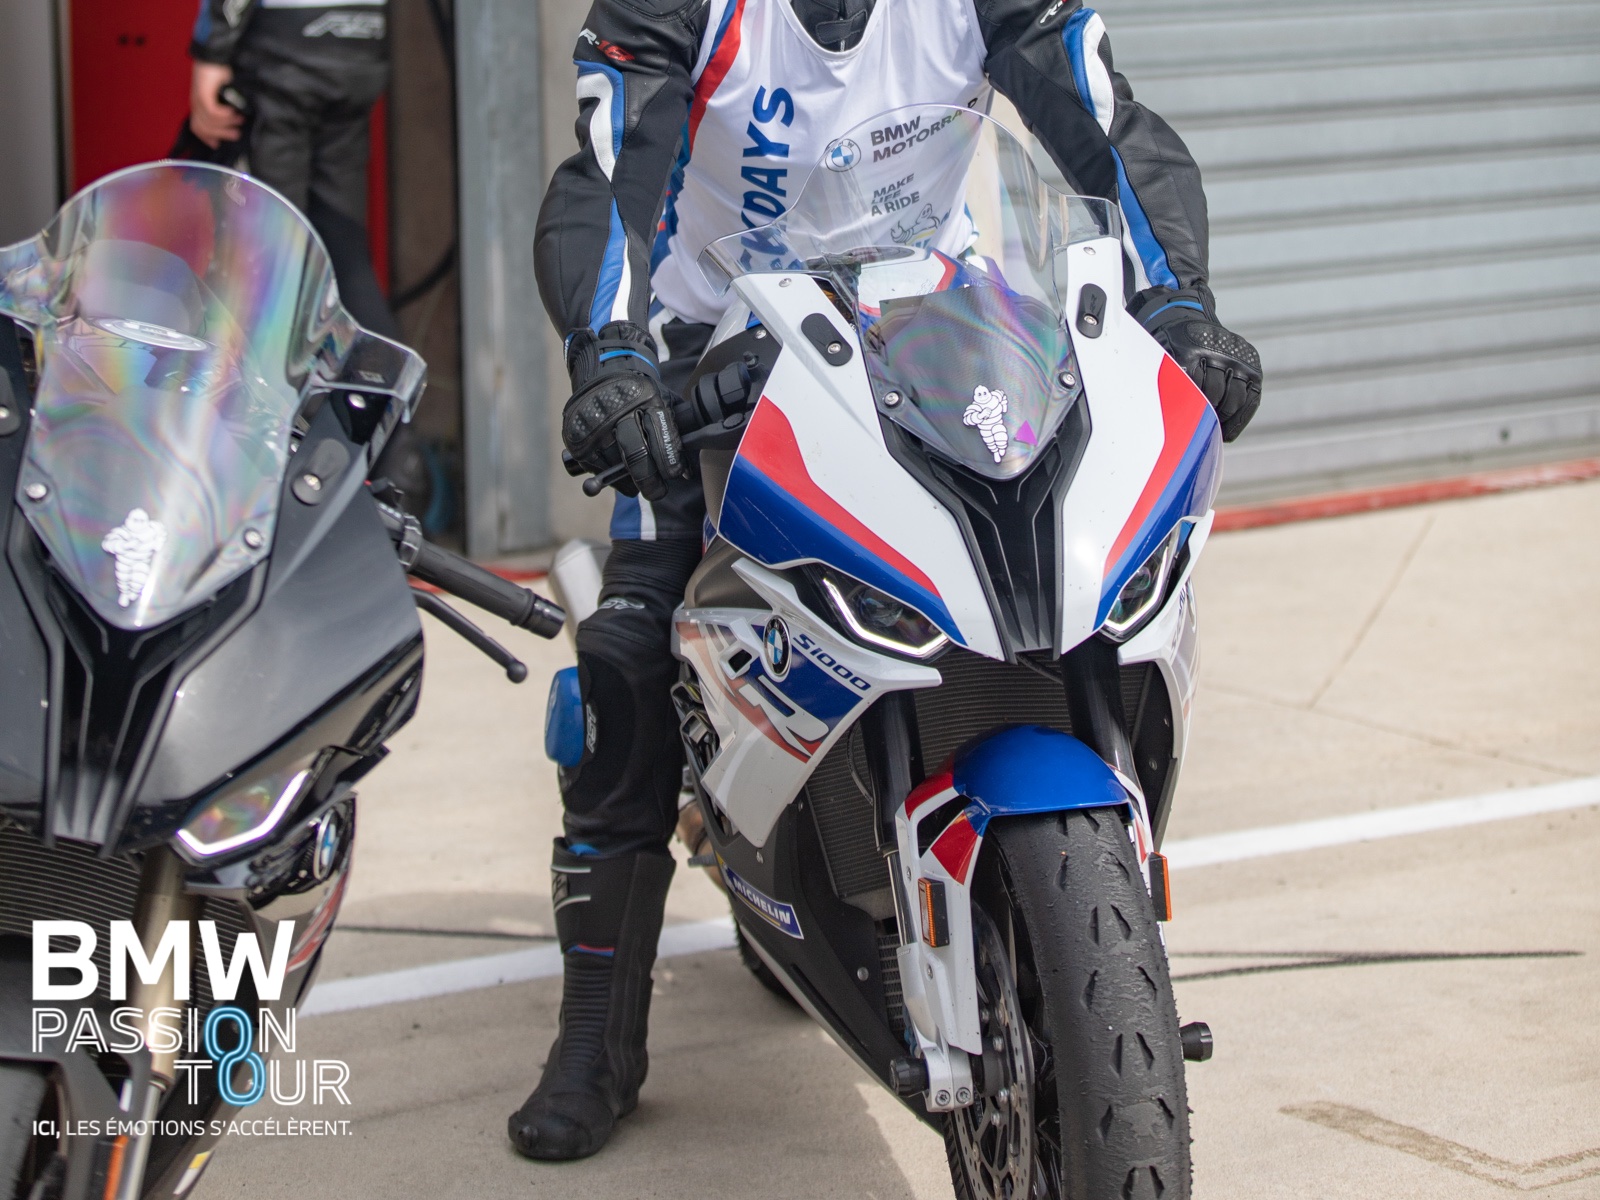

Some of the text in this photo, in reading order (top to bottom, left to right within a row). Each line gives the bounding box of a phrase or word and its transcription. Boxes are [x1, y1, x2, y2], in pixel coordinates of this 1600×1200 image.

[870, 115, 921, 147] BMW
[871, 189, 902, 205] LIFE
[873, 173, 915, 199] MAKE
[871, 191, 920, 217] A RIDE
[664, 443, 677, 465] BMW
[793, 633, 871, 692] S1000
[732, 877, 791, 925] MICHELIN
